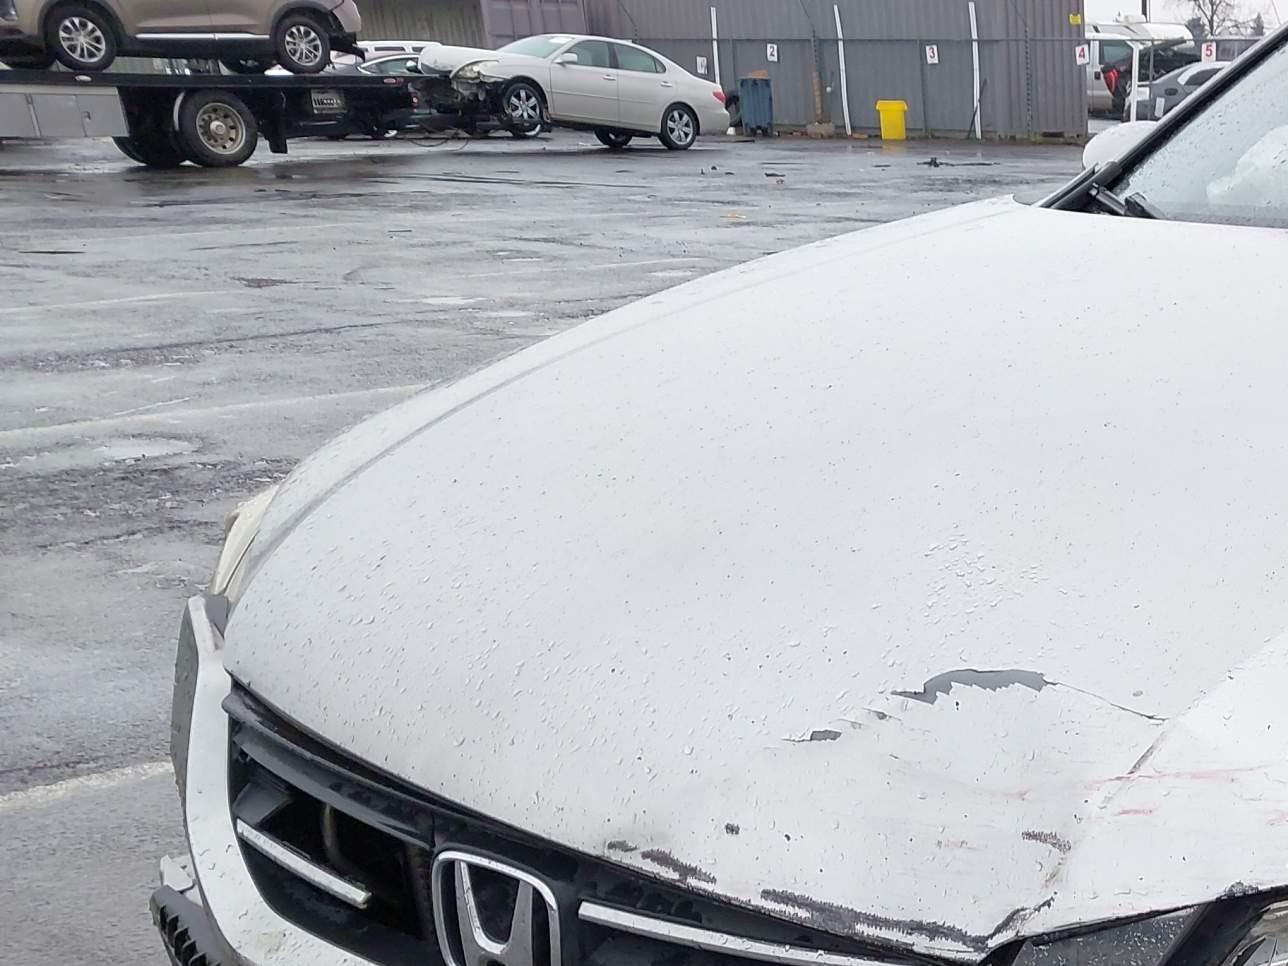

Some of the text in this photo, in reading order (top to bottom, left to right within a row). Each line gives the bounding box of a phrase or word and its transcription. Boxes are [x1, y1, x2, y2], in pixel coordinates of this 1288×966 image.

[769, 46, 775, 57] 2
[929, 47, 936, 59] 3
[1078, 47, 1086, 59] 4
[1205, 45, 1213, 57] 5
